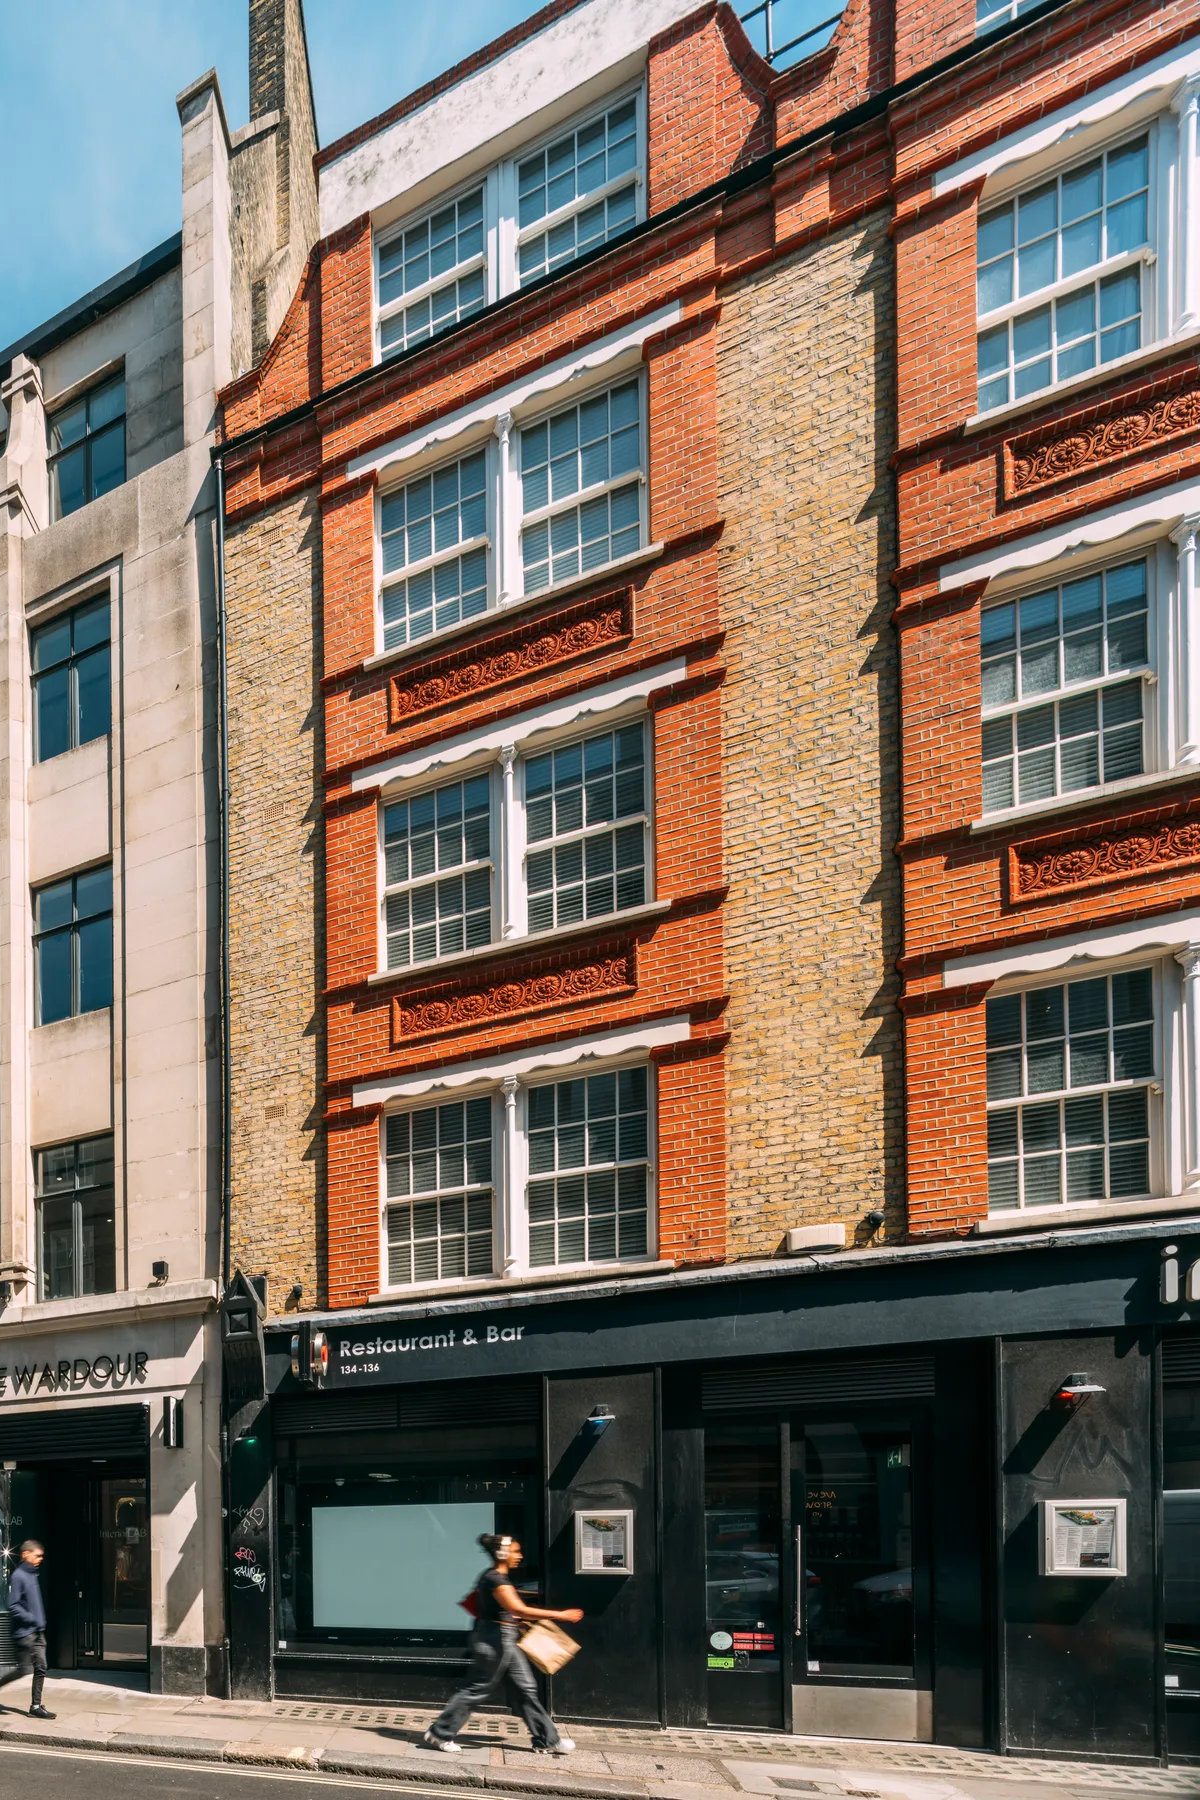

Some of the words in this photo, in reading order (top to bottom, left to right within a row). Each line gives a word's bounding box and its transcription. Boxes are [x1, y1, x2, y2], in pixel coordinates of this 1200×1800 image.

[340, 1330, 456, 1357] Restaurant
[462, 1328, 478, 1345] &
[486, 1325, 526, 1343] Bar
[14, 1351, 149, 1386] WARDOUR
[340, 1363, 380, 1375] 134-136
[100, 1527, 148, 1539] InteriorLAB
